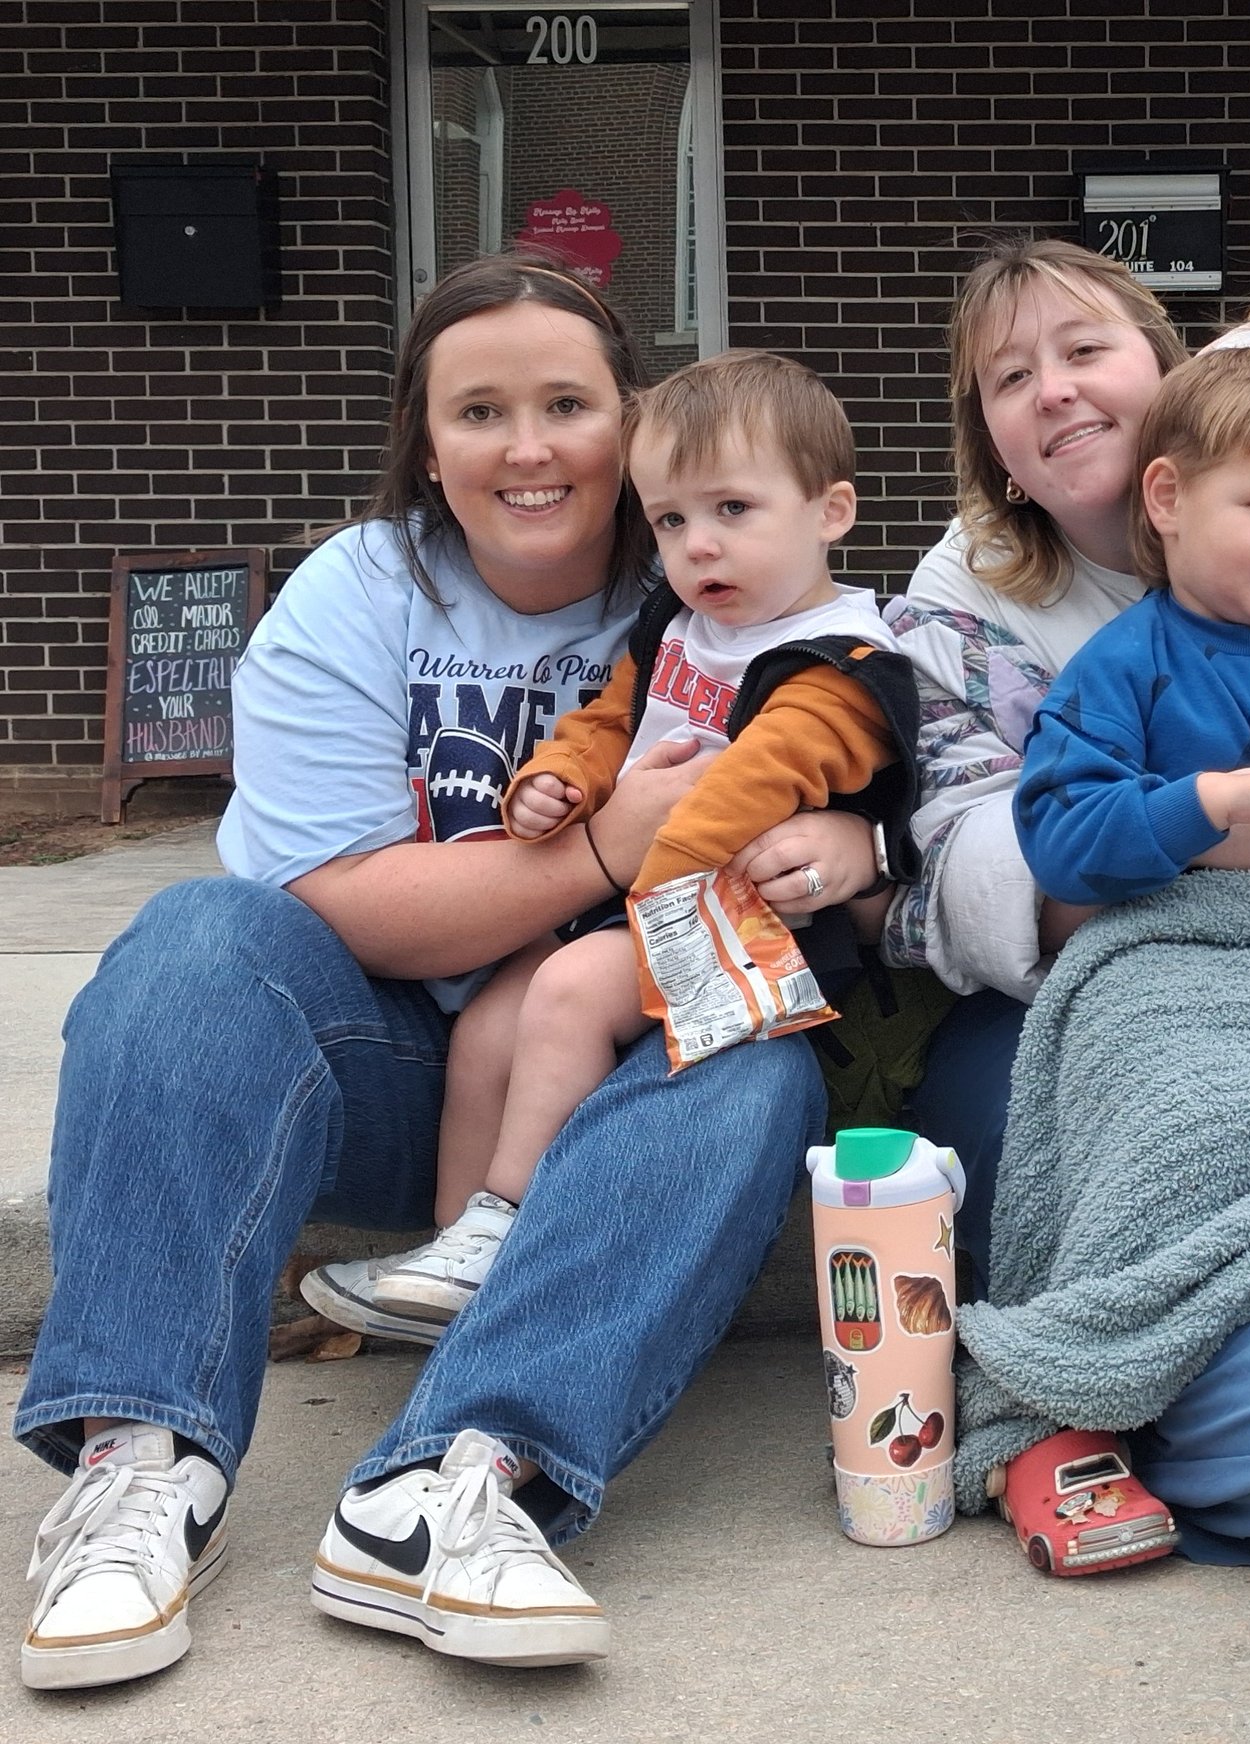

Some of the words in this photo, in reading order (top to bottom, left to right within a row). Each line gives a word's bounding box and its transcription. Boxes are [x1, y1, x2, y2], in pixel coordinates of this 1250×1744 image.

[526, 15, 598, 64] 200
[1099, 219, 1149, 260] 201
[1118, 261, 1154, 272] UITE
[1170, 260, 1194, 272] 104
[132, 573, 173, 601] WE
[185, 570, 244, 600] ACCEPT
[181, 602, 233, 628] MAJOR
[131, 631, 188, 655] CREDIT
[194, 627, 240, 651] CARDS
[127, 656, 239, 694] ESPECIAL
[409, 648, 527, 680] Warren
[557, 654, 613, 685] Pion
[159, 693, 194, 719] YOUR
[408, 683, 556, 768] AME
[189, 750, 201, 758] BY
[641, 901, 675, 919] Nutrition
[649, 930, 678, 946] Calories
[94, 1438, 117, 1453] NIKE
[502, 1455, 519, 1473] NIKE
